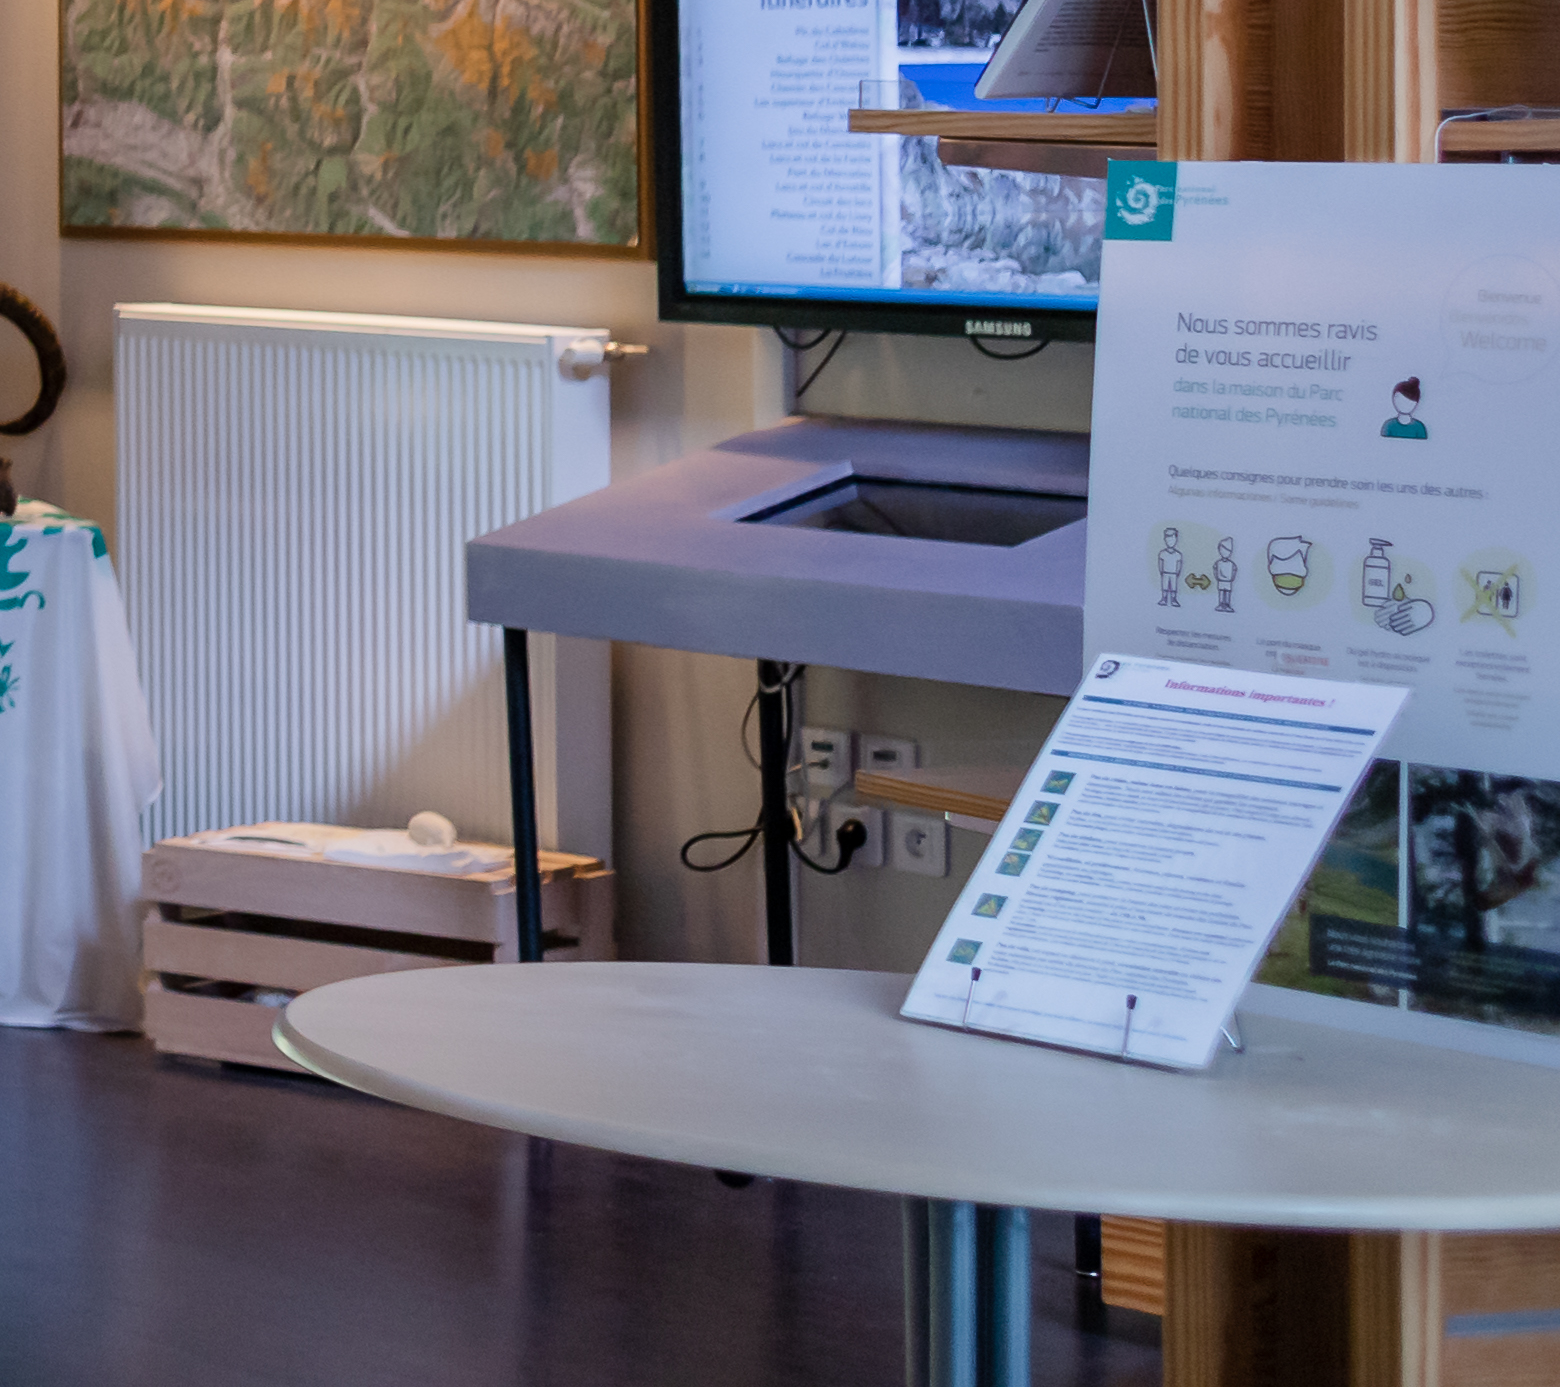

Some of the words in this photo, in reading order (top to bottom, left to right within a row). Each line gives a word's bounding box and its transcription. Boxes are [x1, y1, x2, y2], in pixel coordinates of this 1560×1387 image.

[965, 319, 1032, 336] SAMSUNG
[1176, 312, 1228, 334] Nous
[1233, 319, 1321, 339] sommes
[1326, 319, 1378, 342] ravis
[1460, 330, 1548, 352] Welcome
[1175, 343, 1199, 364] de
[1204, 348, 1252, 367] vous
[1257, 348, 1352, 371] accueillir
[1172, 376, 1208, 393] dans
[1211, 378, 1227, 395] la
[1228, 381, 1284, 398] maison
[1287, 382, 1306, 400] du
[1309, 383, 1344, 402] Parc
[1171, 404, 1232, 421] national
[1234, 407, 1263, 423] des
[1265, 407, 1338, 428] Pyrénées
[1168, 464, 1219, 480] Quelques
[1220, 470, 1275, 485] consignes
[1276, 474, 1302, 487] pour
[1304, 476, 1349, 489] prendre
[1376, 479, 1394, 494] les
[1420, 482, 1442, 497] des
[1443, 485, 1484, 500] autres
[1165, 679, 1247, 698] Informations
[1249, 689, 1326, 708] importantes
